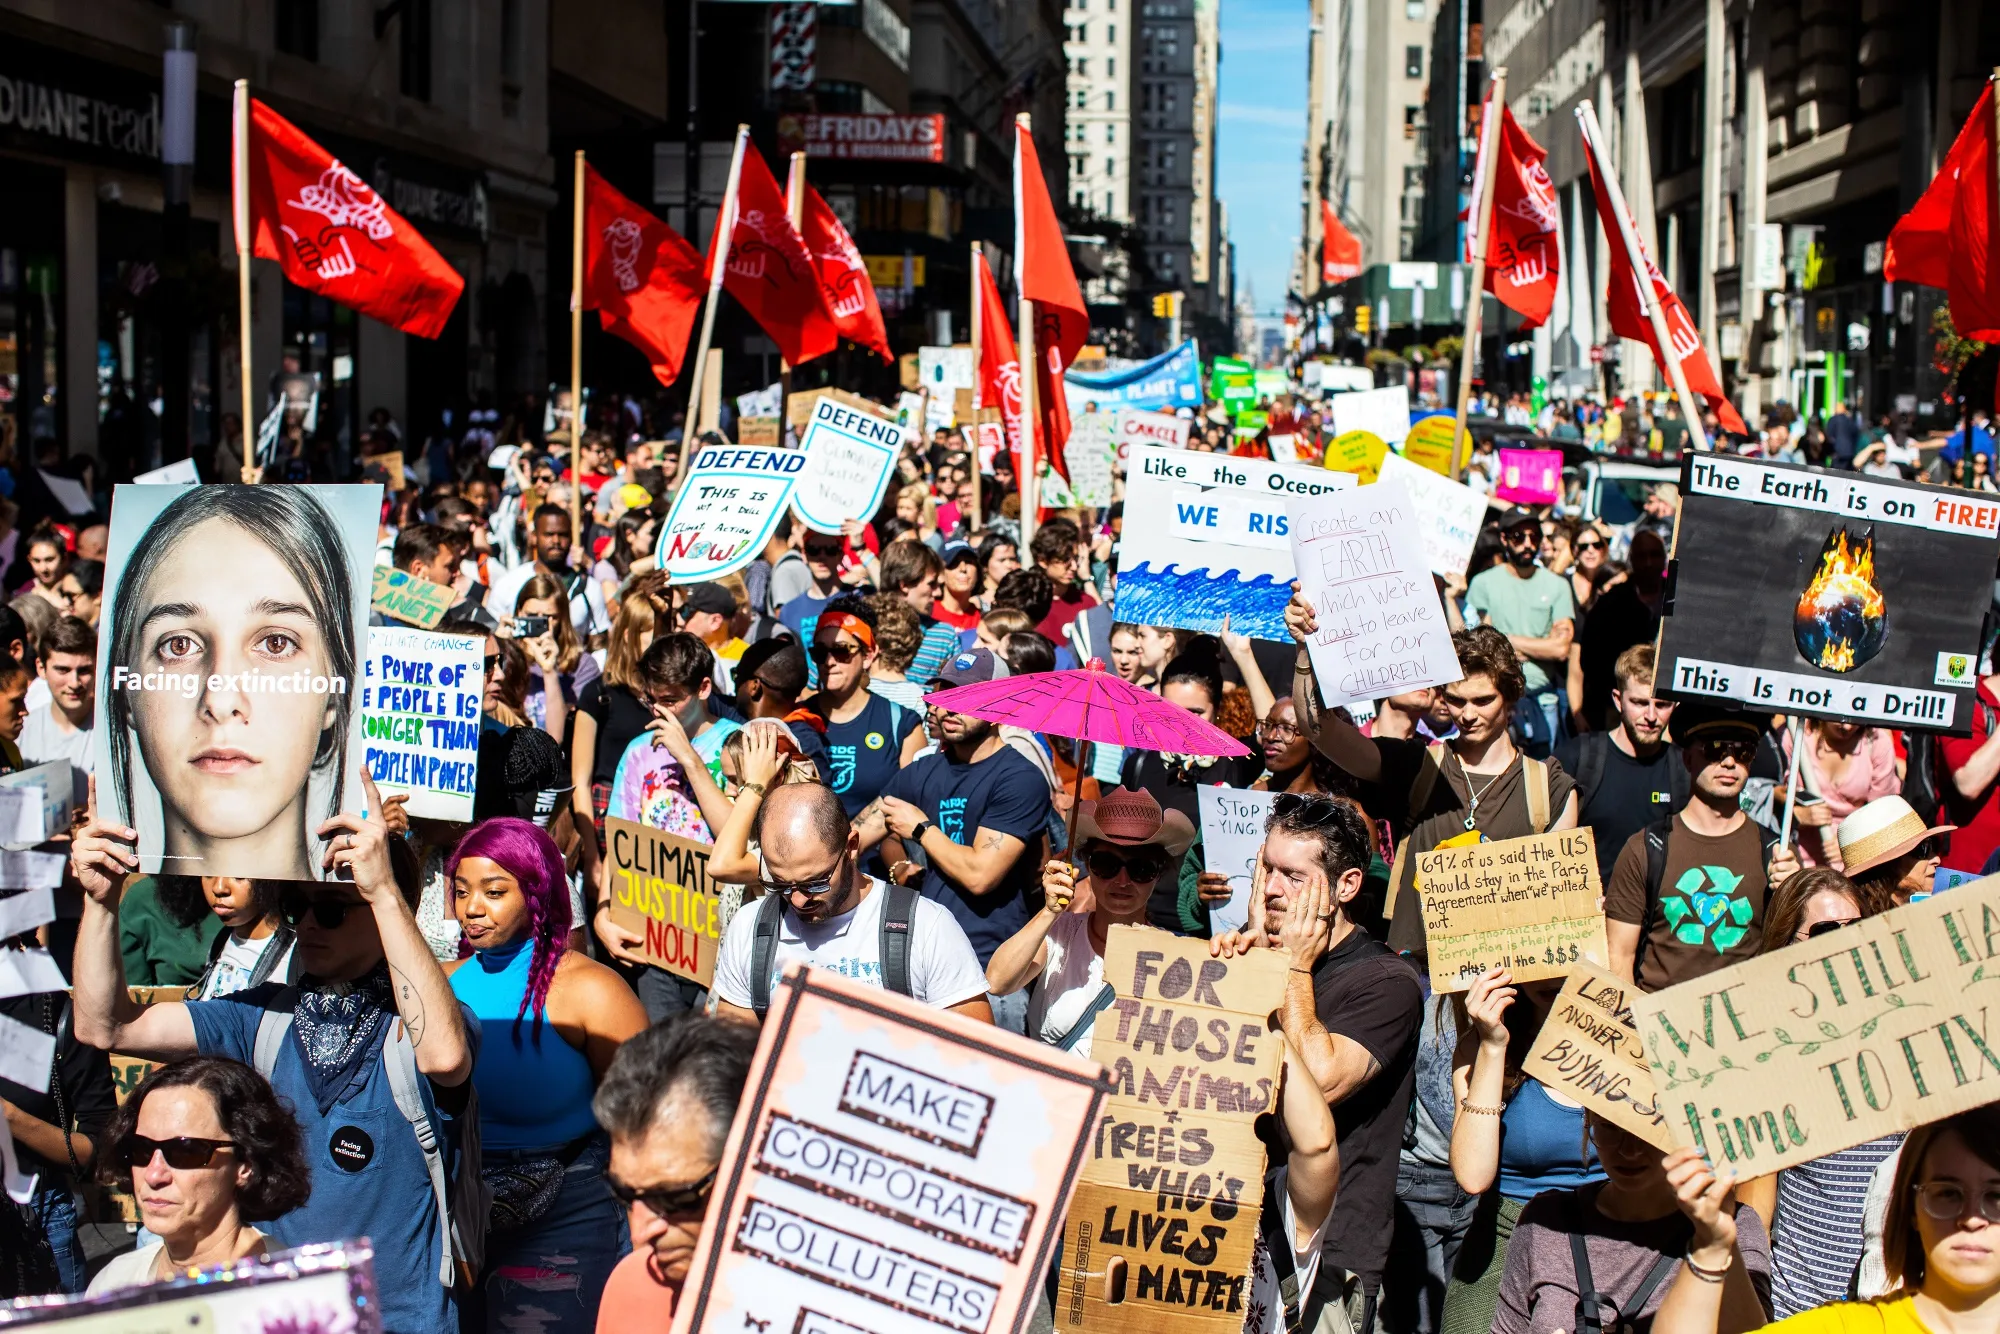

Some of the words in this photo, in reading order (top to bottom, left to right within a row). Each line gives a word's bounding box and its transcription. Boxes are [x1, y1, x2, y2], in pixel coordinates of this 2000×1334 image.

[91, 91, 161, 159] read
[819, 116, 936, 142] FRIDAYS
[817, 402, 900, 446] DEFEND
[697, 450, 806, 473] DEFEND
[1144, 458, 1188, 478] Like
[1213, 466, 1247, 486] the
[700, 486, 740, 499] THIS
[749, 491, 768, 501] IS
[1694, 464, 1740, 491] The
[1760, 472, 1829, 503] Earth
[1847, 487, 1868, 511] is
[1883, 499, 1916, 519] on
[1934, 500, 1998, 530] FIRE!
[1177, 503, 1219, 528] WE
[1248, 512, 1289, 536] RIS
[1295, 508, 1363, 544] Create
[1370, 506, 1403, 527] an
[1320, 530, 1395, 583] EARTH
[1358, 614, 1377, 637] to
[1382, 605, 1433, 631] leave
[424, 638, 475, 652] CHANGE
[1343, 640, 1383, 665] for
[1390, 631, 1430, 655] our
[113, 667, 199, 698] Facing
[207, 668, 346, 694] extinction
[382, 654, 433, 686] POWER
[439, 664, 467, 688] OF
[1340, 656, 1427, 694] CHILDREN
[378, 686, 446, 716] PEOPLE
[456, 693, 479, 719] IS
[1680, 665, 1730, 693] This
[1753, 676, 1773, 699] Is
[1788, 687, 1832, 708] not
[1851, 695, 1868, 712] a
[1883, 693, 1947, 721] Drill!
[426, 719, 478, 750] THAN
[366, 747, 409, 785] PEOPLE
[411, 753, 427, 785] IN
[429, 755, 475, 793] POWER
[1216, 796, 1260, 818] STOP
[1422, 852, 1457, 874] 69%
[1461, 851, 1475, 868] of
[1479, 855, 1493, 868] us
[1500, 844, 1527, 865] said
[1530, 842, 1555, 862] the
[1560, 835, 1588, 858] US
[1424, 873, 1470, 895] should
[1474, 871, 1502, 892] stay
[1508, 869, 1520, 883] in
[1524, 865, 1546, 881] the
[1551, 861, 1589, 879] Paris
[1426, 888, 1497, 914] Agreement
[1500, 887, 1528, 905] when
[1551, 875, 1590, 900] pulled
[617, 868, 719, 940] JUSTICE
[1428, 917, 1453, 930] out.
[646, 916, 698, 974] NOW
[1474, 925, 1539, 943] ignorance
[1544, 916, 1559, 931] of
[1507, 940, 1518, 950] is
[1520, 932, 1554, 948] their
[1515, 954, 1536, 969] the
[1542, 942, 1580, 966] $$$
[1133, 950, 1229, 1009] FOR
[1648, 982, 1766, 1058] WE
[1788, 928, 1931, 1019] STILL
[1113, 998, 1262, 1065] THOSE
[1540, 1039, 1631, 1102] BUYING
[1818, 1048, 1893, 1122] TO
[1896, 1006, 2000, 1099] FIX
[855, 1066, 977, 1135] MAKE
[334, 1146, 366, 1160] extinction
[340, 1139, 361, 1151] Facing
[1095, 1114, 1215, 1167] TREES
[1682, 1101, 1810, 1169] time
[772, 1126, 1023, 1242] CORPORATE
[1127, 1163, 1245, 1221] WHO'S
[1099, 1205, 1228, 1266] LIVES
[748, 1210, 985, 1322] POLLUTERS
[1136, 1263, 1248, 1313] MATTER
